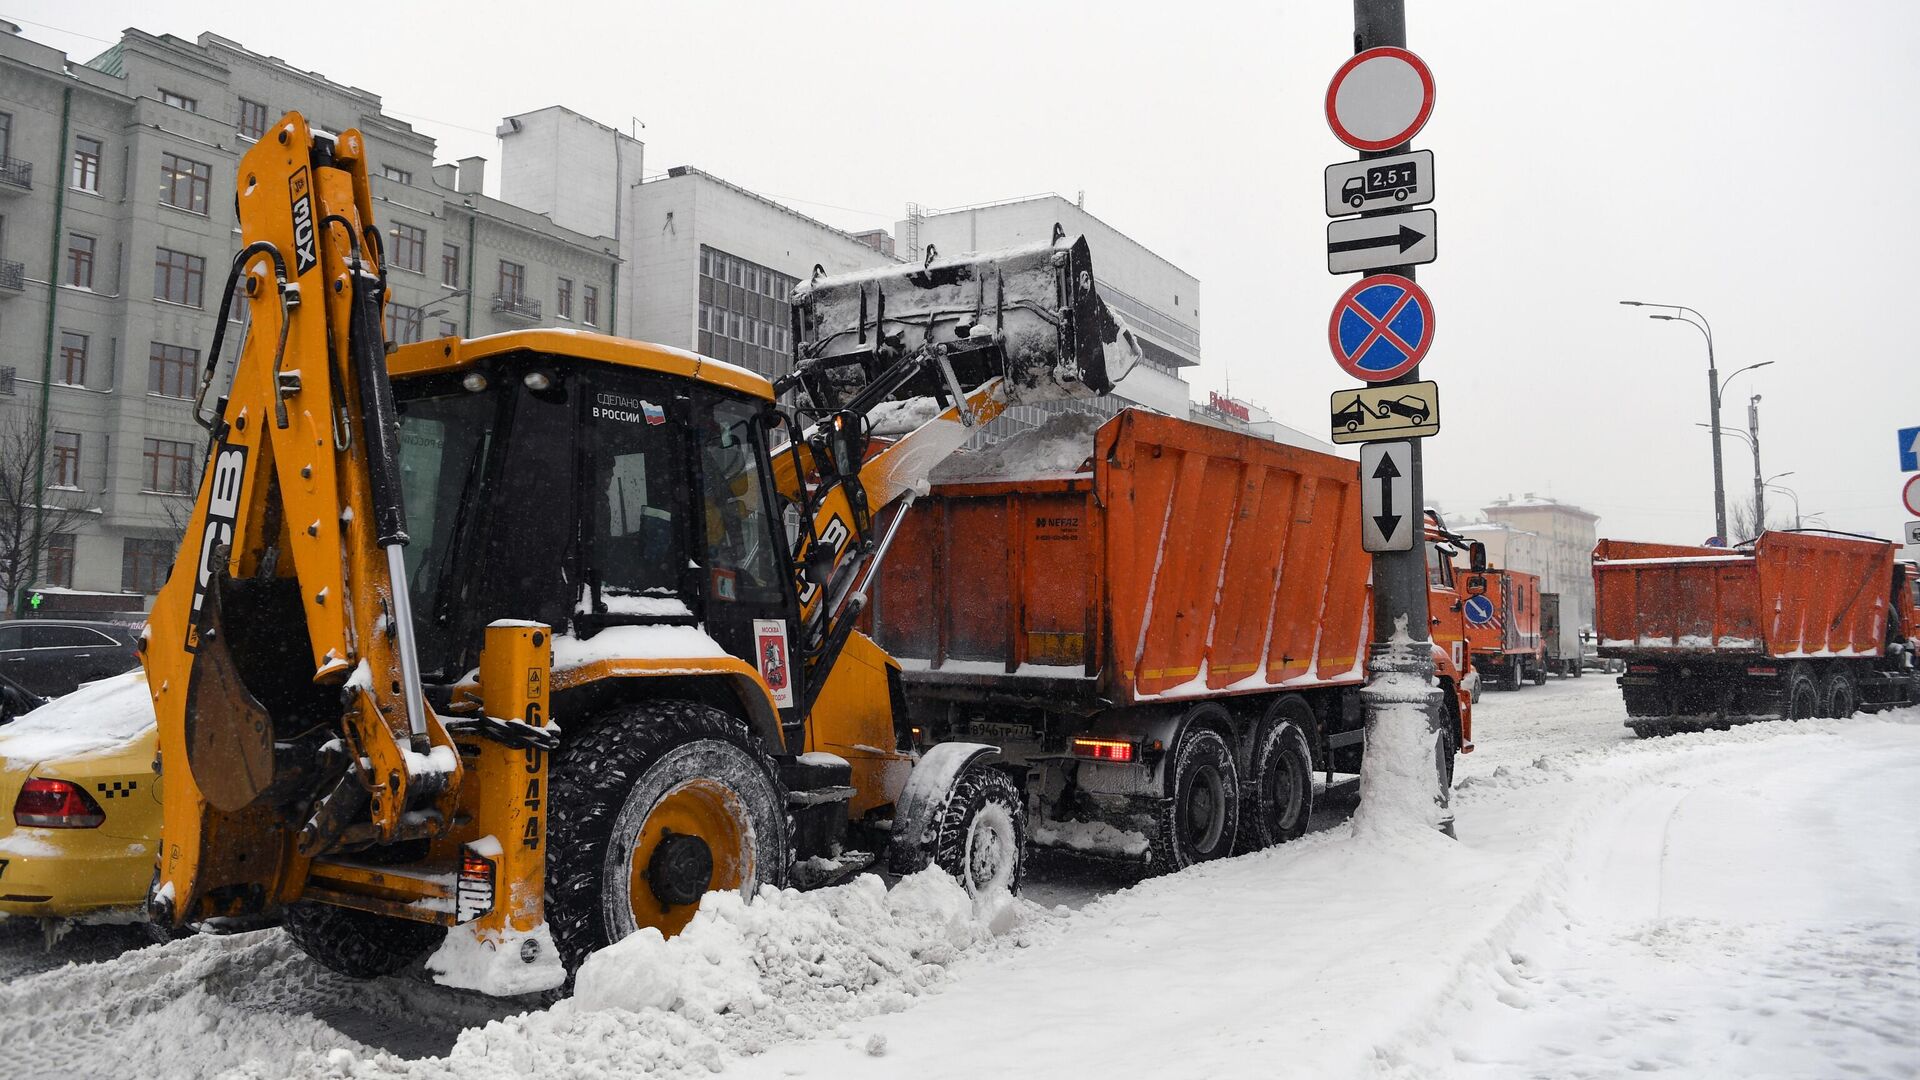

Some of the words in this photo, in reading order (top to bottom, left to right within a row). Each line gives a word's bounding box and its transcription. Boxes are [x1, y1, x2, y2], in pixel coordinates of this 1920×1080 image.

[1373, 170, 1397, 187] 2,5
[294, 197, 316, 271] 3CX
[597, 393, 639, 409] СДЕЛАНО
[592, 407, 600, 417] В
[602, 408, 640, 423] РОССИИ
[194, 450, 243, 611] CB
